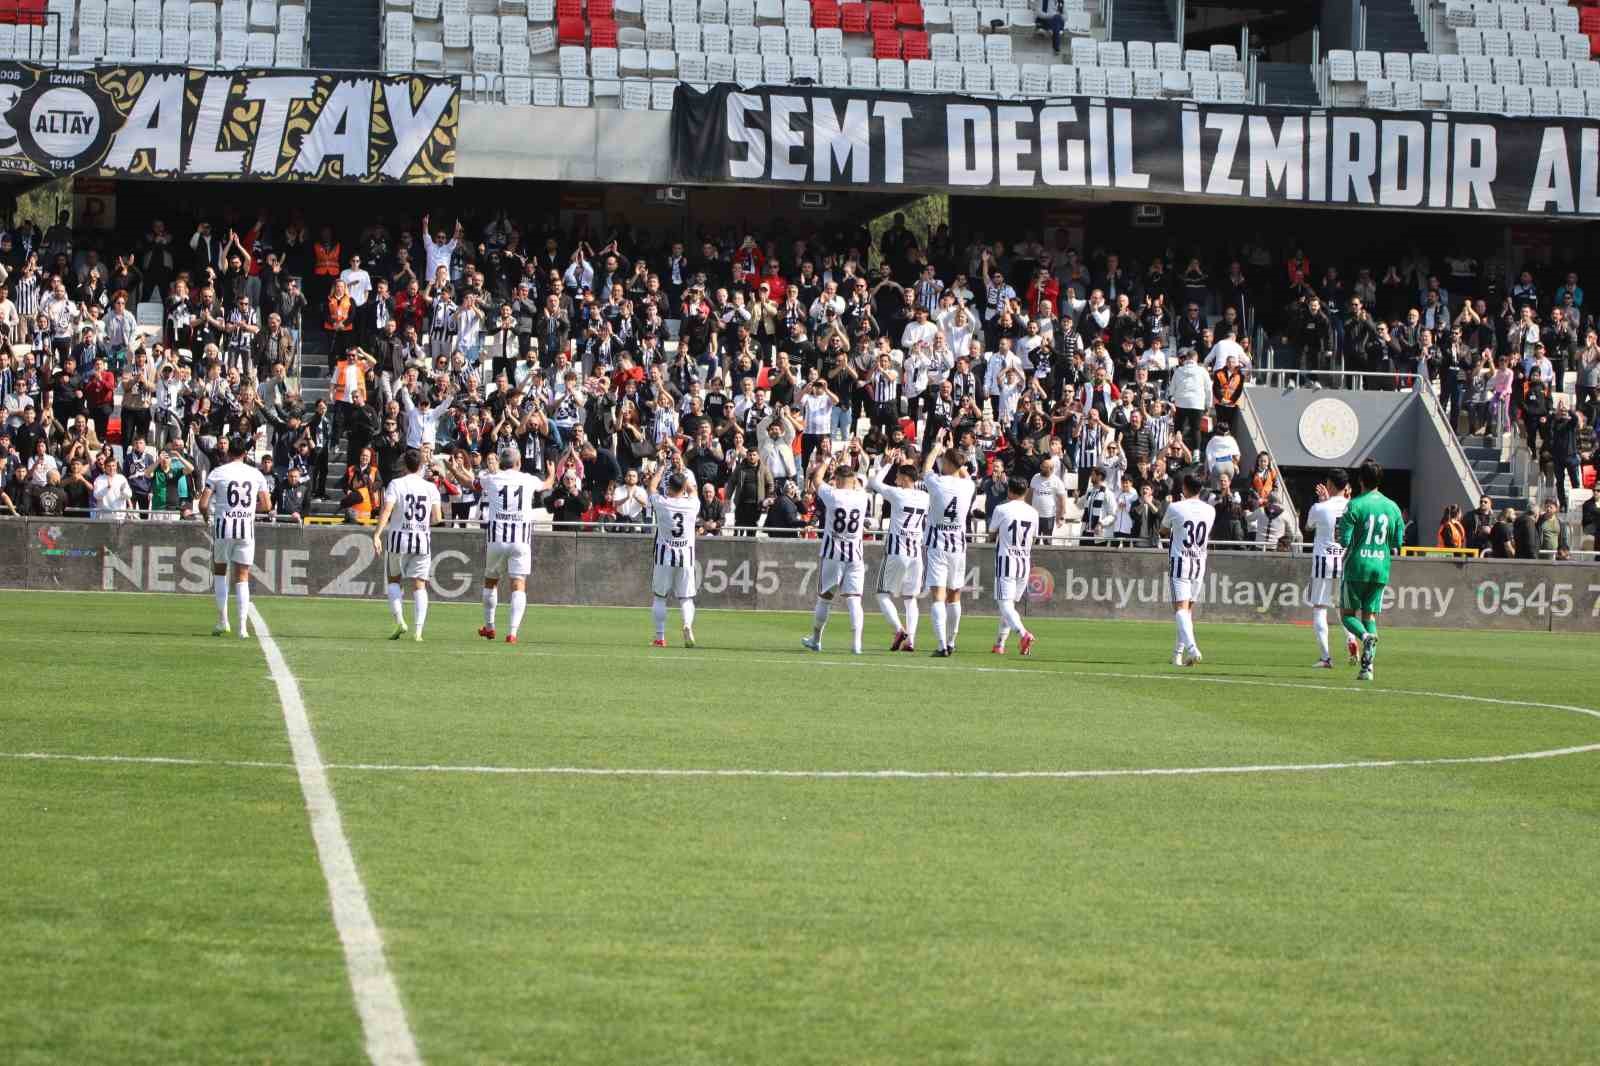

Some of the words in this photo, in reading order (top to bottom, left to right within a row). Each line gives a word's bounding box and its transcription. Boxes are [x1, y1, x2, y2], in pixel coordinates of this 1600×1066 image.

[36, 110, 94, 134] ALTAY
[101, 73, 458, 181] ALTAY
[726, 91, 914, 185] SEMT
[1181, 102, 1497, 209] İZMİRDİR
[49, 160, 76, 170] 1914
[227, 480, 252, 508] 63
[404, 493, 426, 522] 35
[498, 485, 524, 511] 11
[833, 507, 861, 534] 88
[903, 506, 925, 529] 77
[943, 496, 957, 523] 4
[671, 512, 684, 538] 3
[1007, 519, 1032, 547] 17
[1182, 520, 1207, 548] 30
[1365, 512, 1389, 545] 13
[104, 545, 310, 595] NESNE
[1477, 580, 1574, 617] 0545
